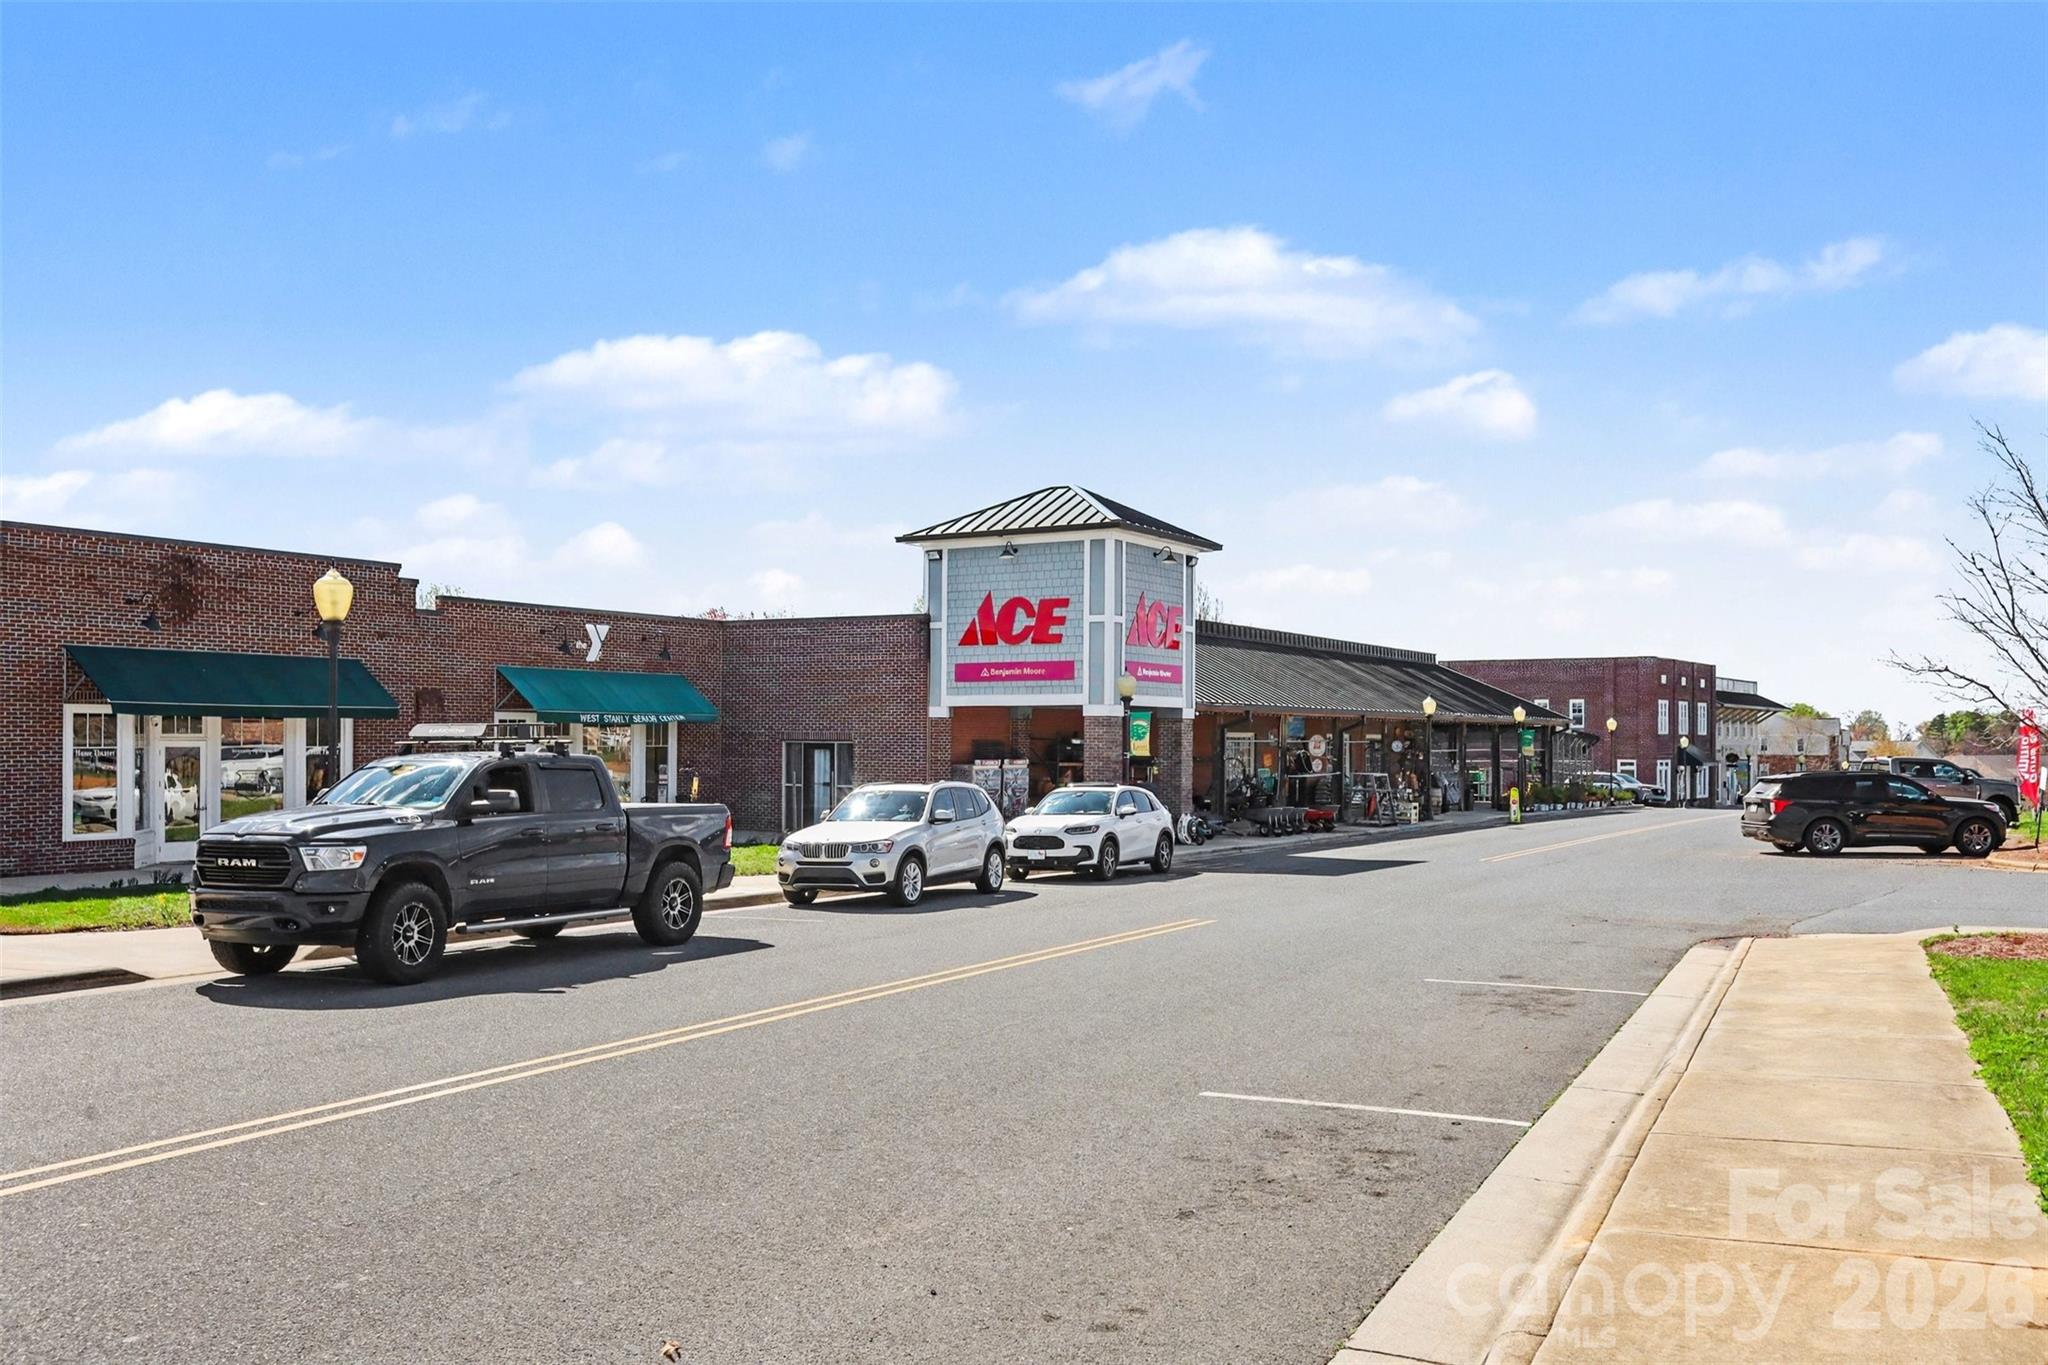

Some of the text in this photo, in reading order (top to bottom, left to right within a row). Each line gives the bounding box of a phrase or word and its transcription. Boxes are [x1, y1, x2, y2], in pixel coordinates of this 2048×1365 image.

[958, 589, 1070, 646] ACE
[1125, 591, 1183, 650] ACE
[990, 667, 1046, 677] Benjamin Moore
[580, 713, 600, 723] WEST
[603, 713, 630, 723] STANLY
[217, 857, 257, 867] RAM
[470, 878, 495, 886] RAM
